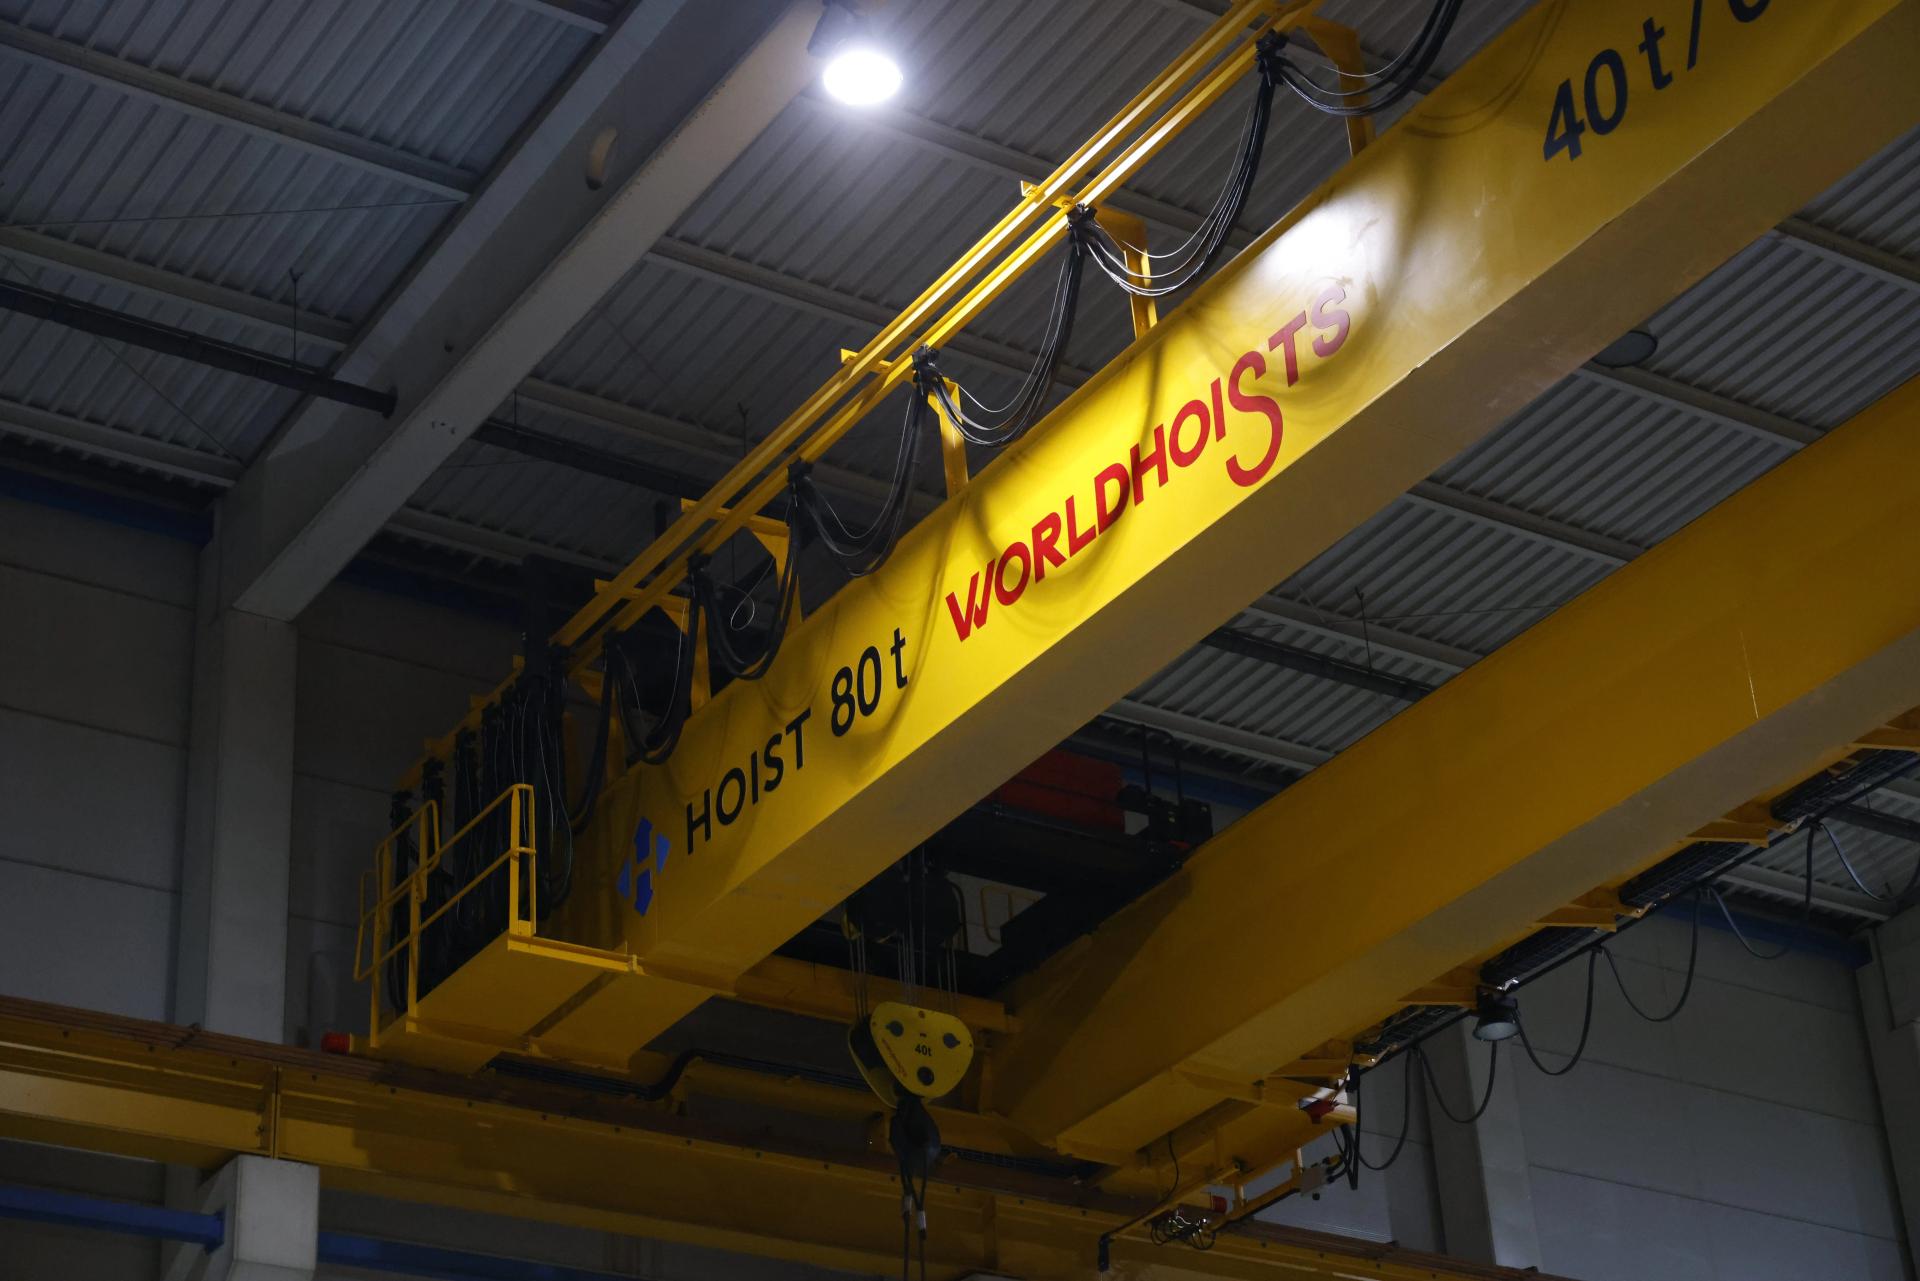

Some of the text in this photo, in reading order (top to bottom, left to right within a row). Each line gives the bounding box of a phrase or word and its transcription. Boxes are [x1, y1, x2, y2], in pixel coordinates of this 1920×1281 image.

[1543, 0, 1770, 161] 40t/
[945, 284, 1351, 642] WORLDHOISTS
[686, 707, 811, 855] HOIST
[914, 1044, 931, 1057] 40t
